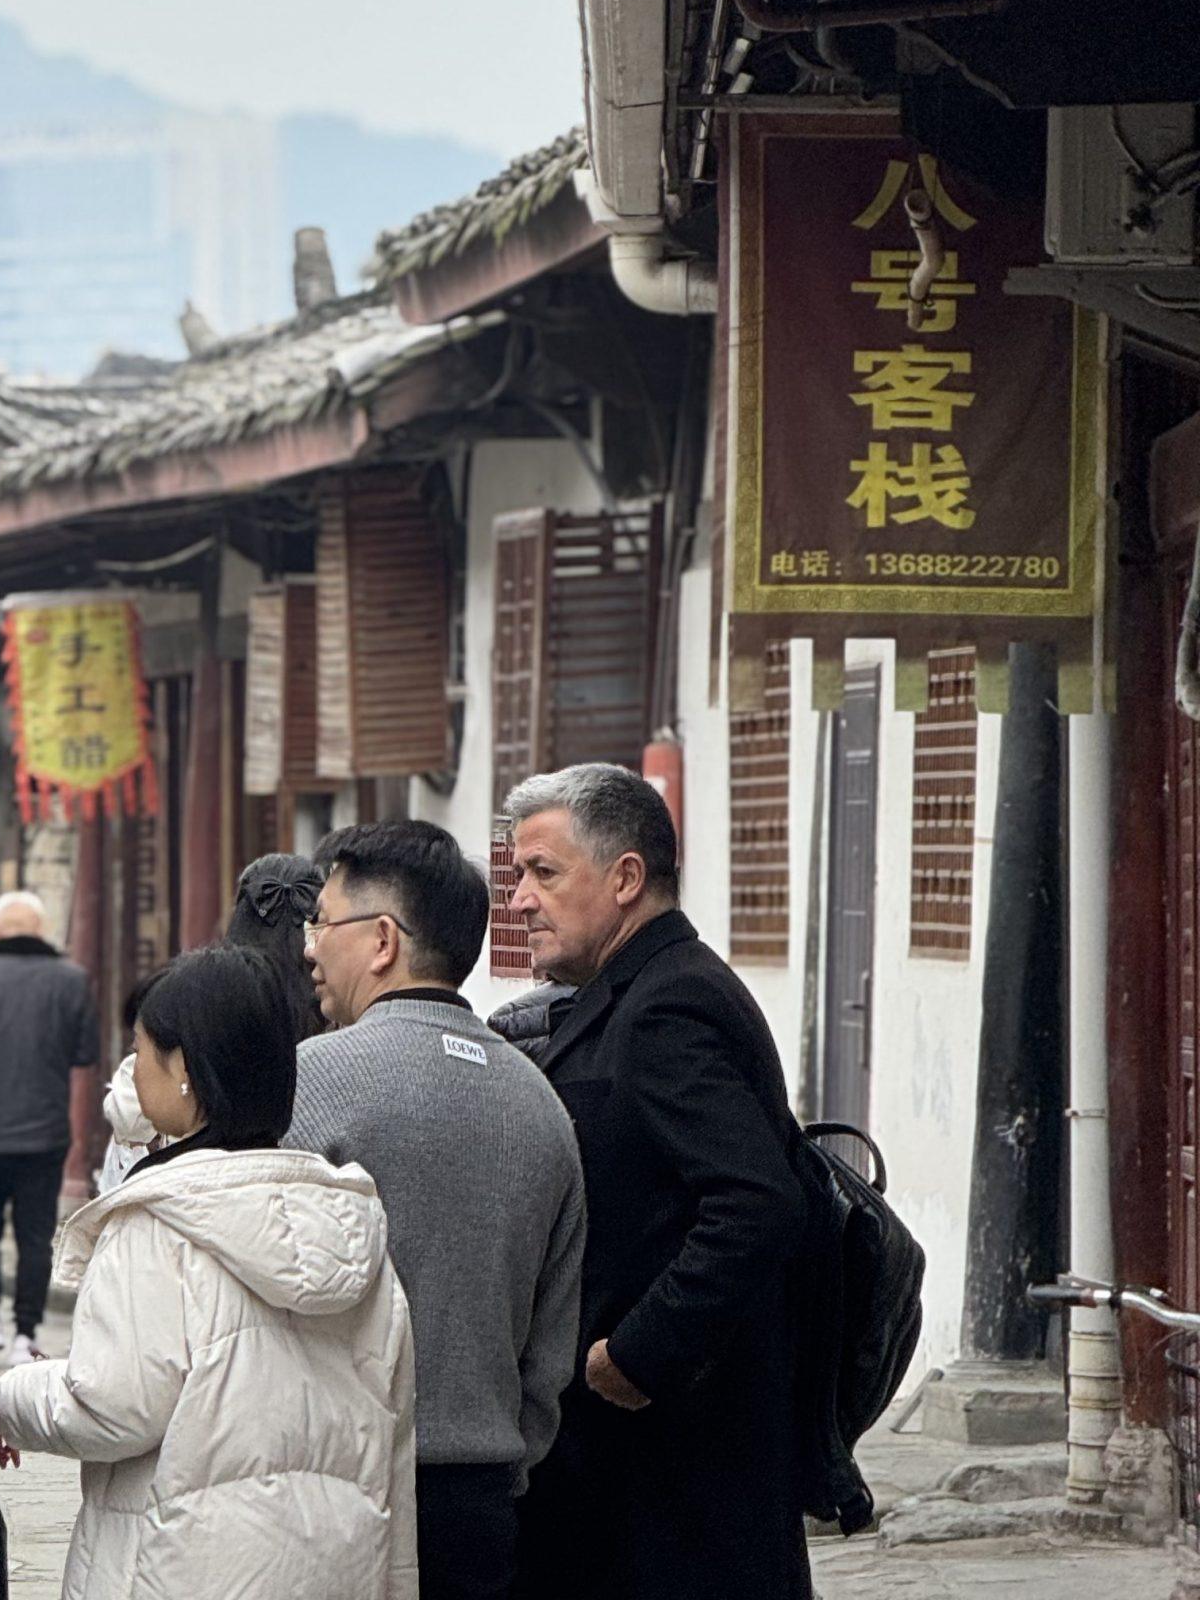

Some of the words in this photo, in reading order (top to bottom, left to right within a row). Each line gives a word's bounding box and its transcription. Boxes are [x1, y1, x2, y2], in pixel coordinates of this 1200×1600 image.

[845, 153, 977, 530] 八号客栈
[864, 553, 1060, 579] 13688222780
[56, 632, 109, 768] 手工醋
[447, 1039, 485, 1059] LOEWE
